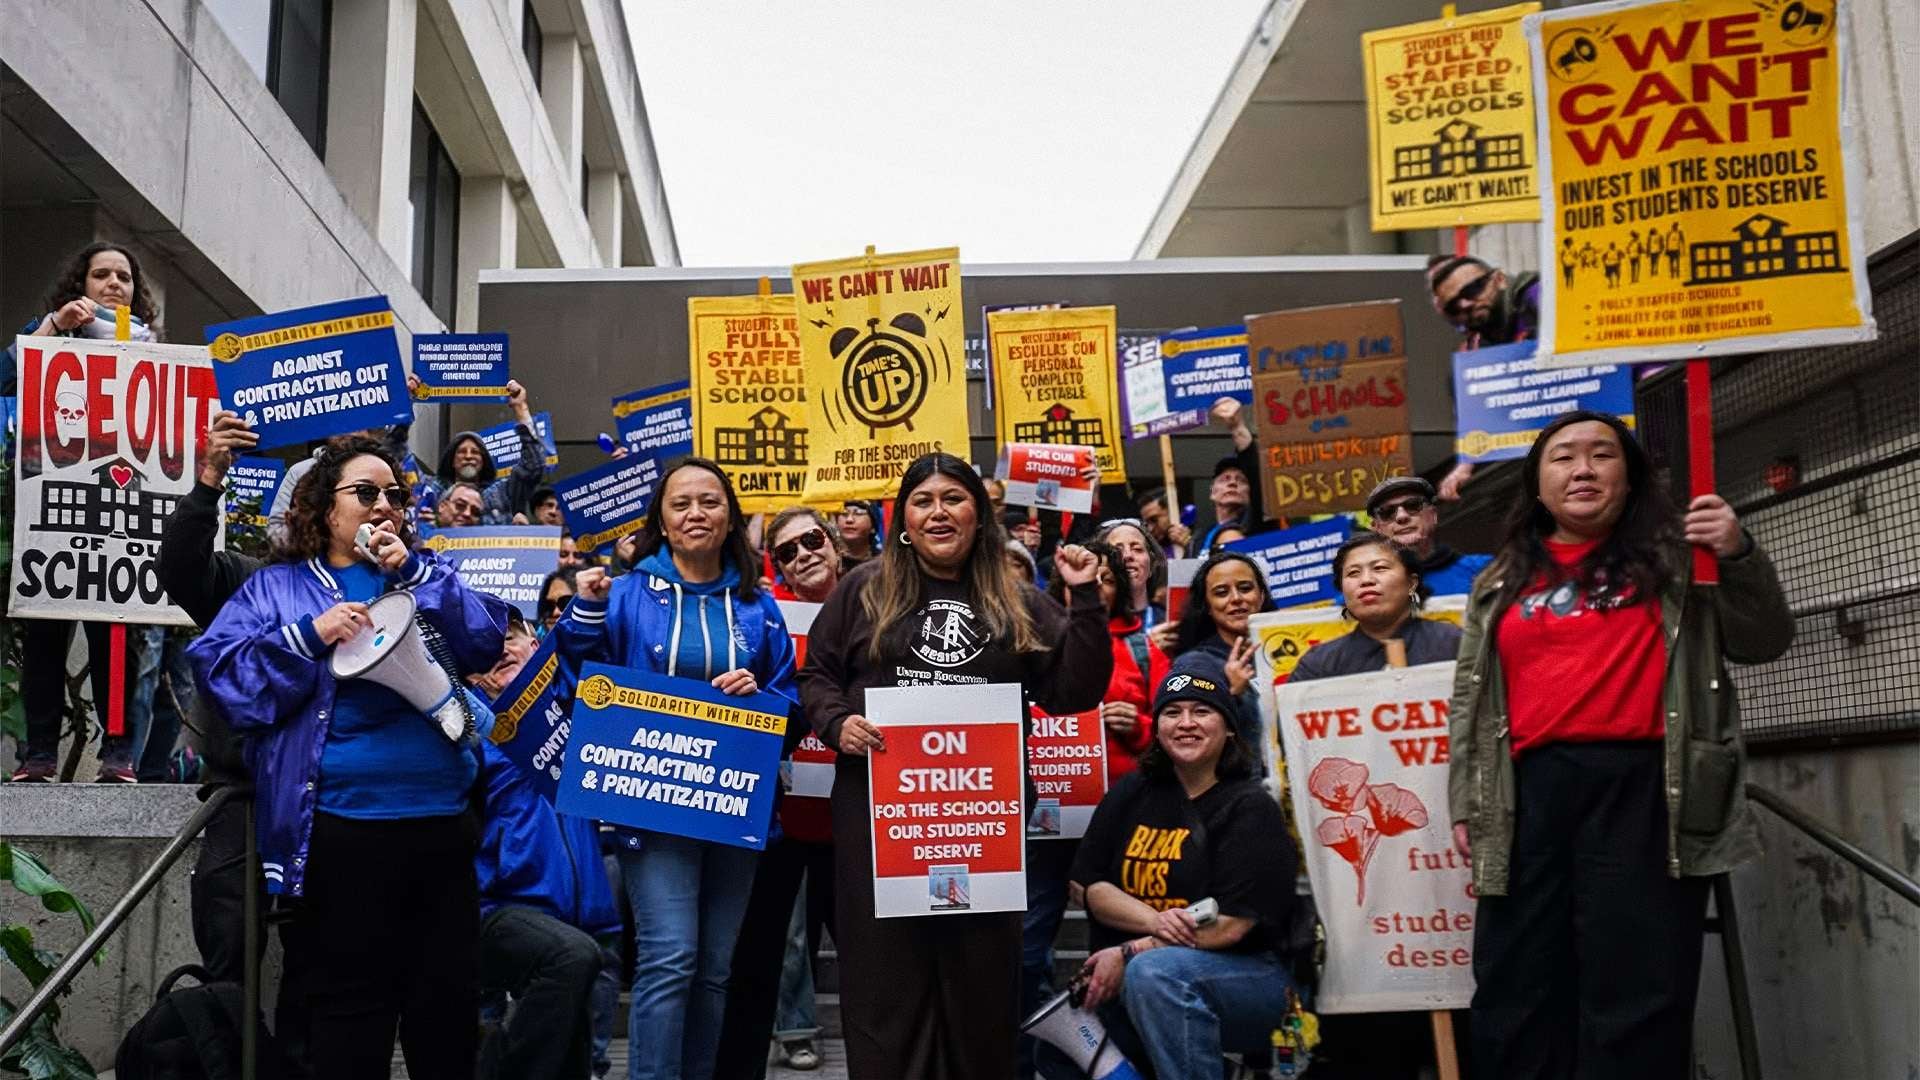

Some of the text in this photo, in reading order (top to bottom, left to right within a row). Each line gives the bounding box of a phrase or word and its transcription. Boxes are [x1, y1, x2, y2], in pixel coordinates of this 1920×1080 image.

[1404, 26, 1504, 50] STUDENTS NEED
[1613, 12, 1764, 72] WE
[1407, 42, 1496, 68] FULLY
[1395, 77, 1506, 106] STABLE
[1558, 47, 1828, 125] CAN'T
[1387, 91, 1524, 124] SCHOOLS
[1565, 95, 1808, 167] WAIT
[1562, 148, 1818, 205] INVEST IN THE SCHOOLS
[1391, 174, 1530, 207] WE CAN'T WAIT!
[1564, 175, 1828, 232] OUR STUDENTS DESERVE
[802, 262, 950, 304] WE CAN'T WAIT
[244, 324, 317, 348] SOLIDARITY
[324, 318, 354, 335] WITH
[726, 332, 800, 348] FULLY
[1073, 341, 1096, 355] CON
[272, 350, 343, 379] AGAINST
[857, 354, 900, 376] TIME'S
[1024, 358, 1083, 373] PERSONAL
[234, 363, 388, 407] CONTRACTING OUT
[860, 368, 910, 412] UP
[1021, 372, 1083, 387] COMPLETO
[263, 385, 389, 424] PRIVATIZATION
[1025, 387, 1086, 402] Y ESTABLE
[1264, 376, 1406, 425] SCHOOLS
[21, 348, 219, 482] ICE OUT
[834, 440, 943, 465] FOR THE SCHOOLS
[1028, 449, 1075, 463] FOR OUR
[739, 471, 783, 492] CAN'T
[787, 471, 806, 492] W
[816, 467, 840, 482] OUR
[844, 462, 903, 481] STUDENTS
[1025, 461, 1076, 477] STUDENTS
[69, 535, 105, 551] OF
[16, 549, 173, 606] SCHOO
[460, 558, 516, 571] AGAINST
[519, 573, 545, 586] OUT
[920, 644, 967, 663] RESIST
[512, 658, 558, 716] SOLIDARITY
[618, 690, 781, 731] SOLIDARITY WITH UESF
[1295, 708, 1363, 741] WE
[533, 718, 572, 770] CONTR
[631, 727, 717, 760] AGAINST
[922, 731, 967, 756] ON
[1036, 745, 1102, 759] SCHOOLS
[580, 743, 760, 793] CONTRACTING OUT
[898, 767, 993, 793] STRIKE
[581, 770, 749, 818] & PRIVATIZATION
[1035, 782, 1072, 794] ERVE
[875, 800, 1020, 819] FOR THE SCHOOLS
[888, 821, 1006, 840] OUR STUDENTS
[913, 843, 983, 860] DESERVE
[1374, 908, 1473, 934] stude
[1387, 943, 1471, 968] dese
